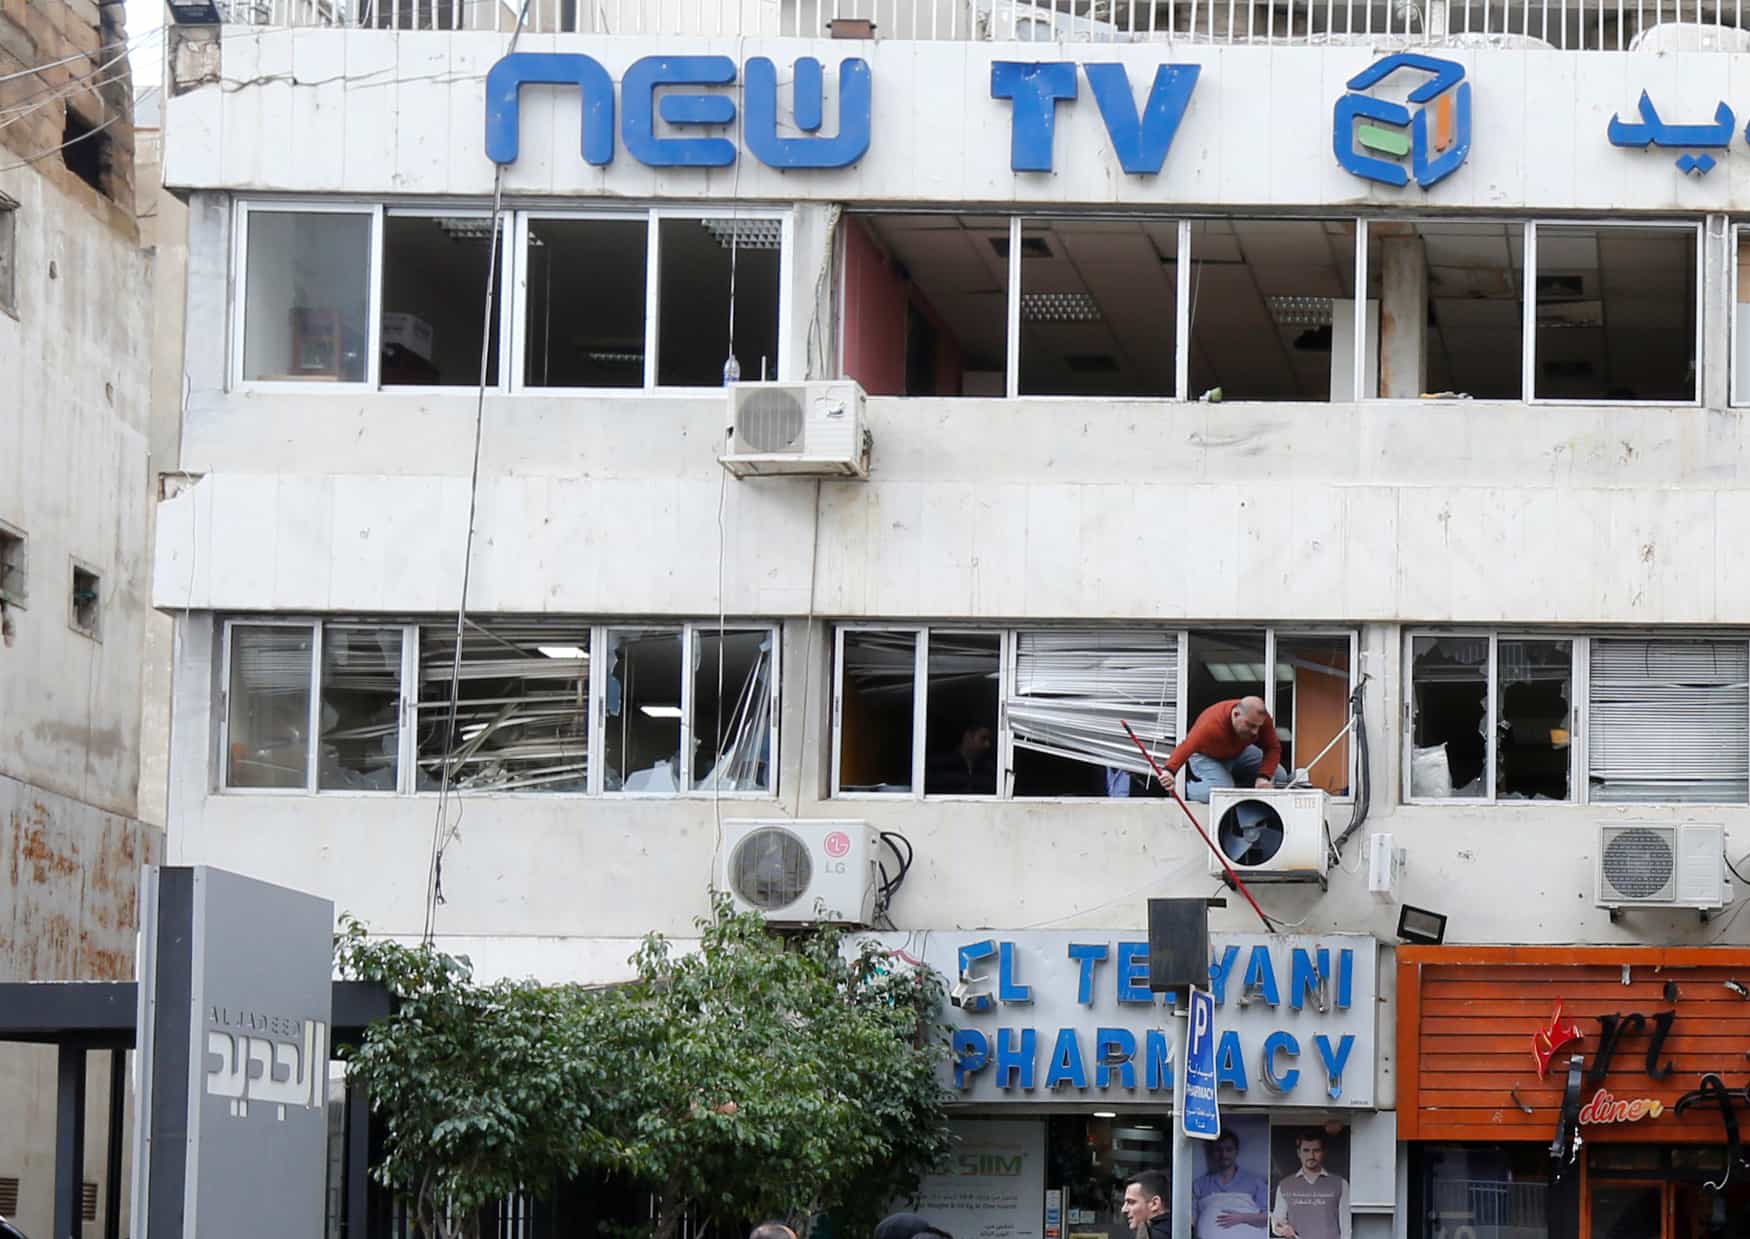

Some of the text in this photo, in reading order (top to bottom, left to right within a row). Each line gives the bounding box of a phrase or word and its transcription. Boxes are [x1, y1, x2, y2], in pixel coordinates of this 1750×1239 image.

[485, 52, 1201, 176] NEW TV
[825, 862, 847, 874] LG
[951, 939, 1355, 1012] EL TEYANI
[208, 1006, 302, 1037] AL JADEED
[1194, 997, 1208, 1056] P
[206, 1019, 326, 1121] الجديد
[952, 1026, 1356, 1099] PHARMACY
[1579, 1087, 1665, 1125] diner
